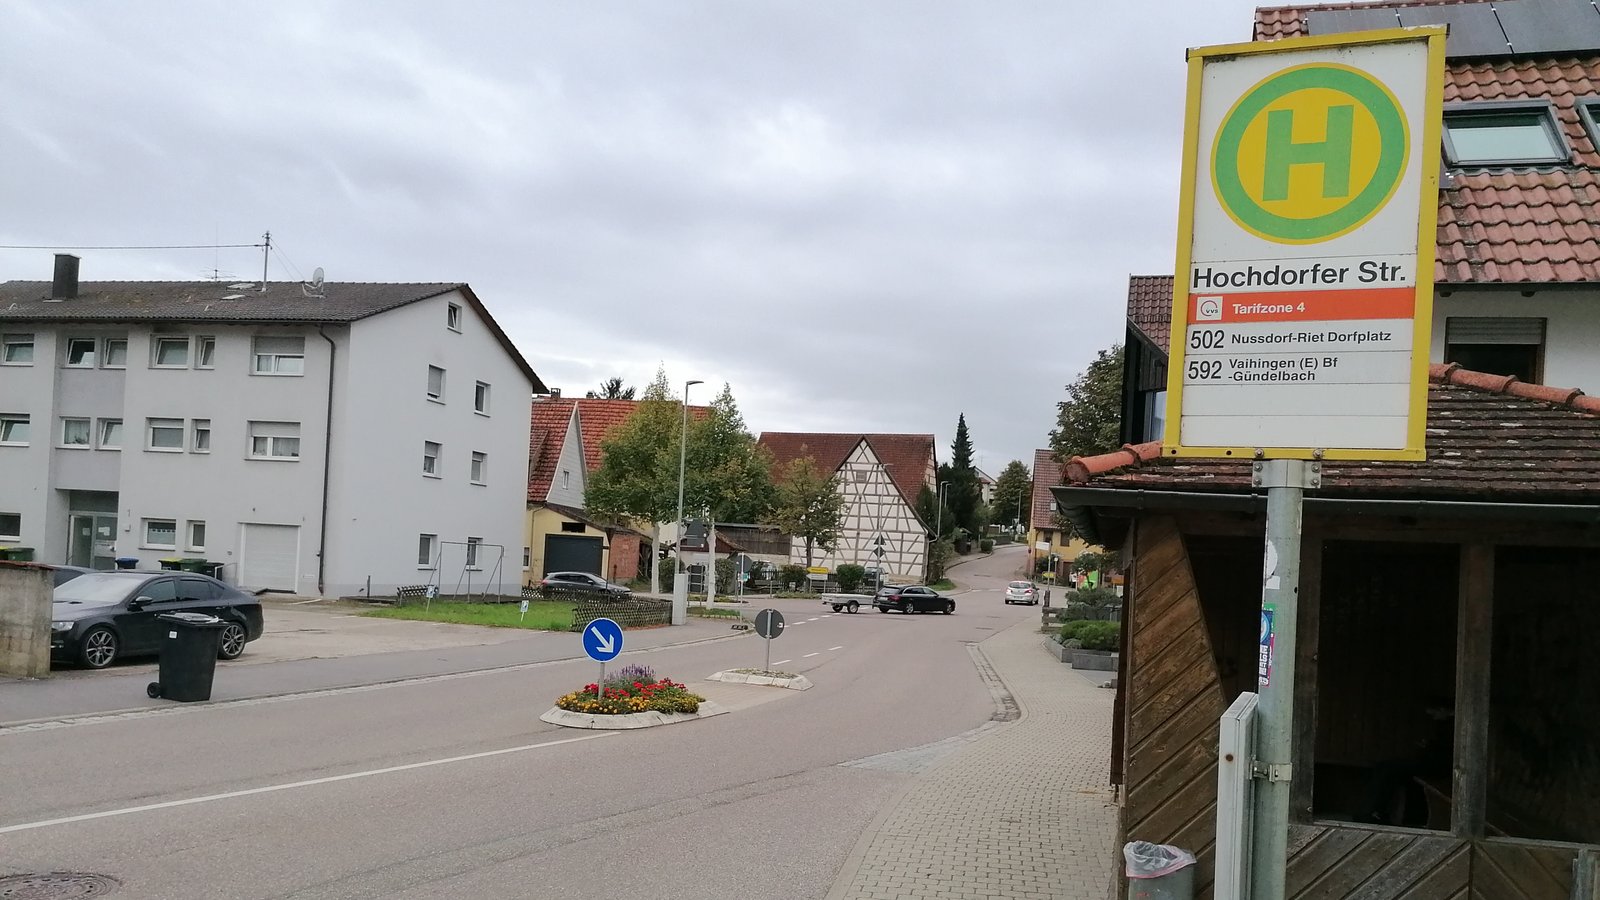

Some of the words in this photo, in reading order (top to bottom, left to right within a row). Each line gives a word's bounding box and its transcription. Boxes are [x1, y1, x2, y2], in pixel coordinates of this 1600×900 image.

[1262, 104, 1354, 202] H
[1193, 263, 1351, 290] Hochdorfer
[1357, 260, 1406, 283] Str.
[1232, 302, 1294, 315] Tarifzone
[1296, 302, 1307, 313] 4
[1190, 329, 1225, 350] 502
[1231, 332, 1325, 345] Nussdorf-Riet
[1328, 330, 1392, 345] Dorfplatz
[1187, 360, 1223, 380] 592
[1229, 358, 1296, 372] Vaihingen
[1299, 357, 1319, 371] (E)
[1322, 356, 1338, 369] Bf
[1228, 370, 1316, 382] -Gündelbach
